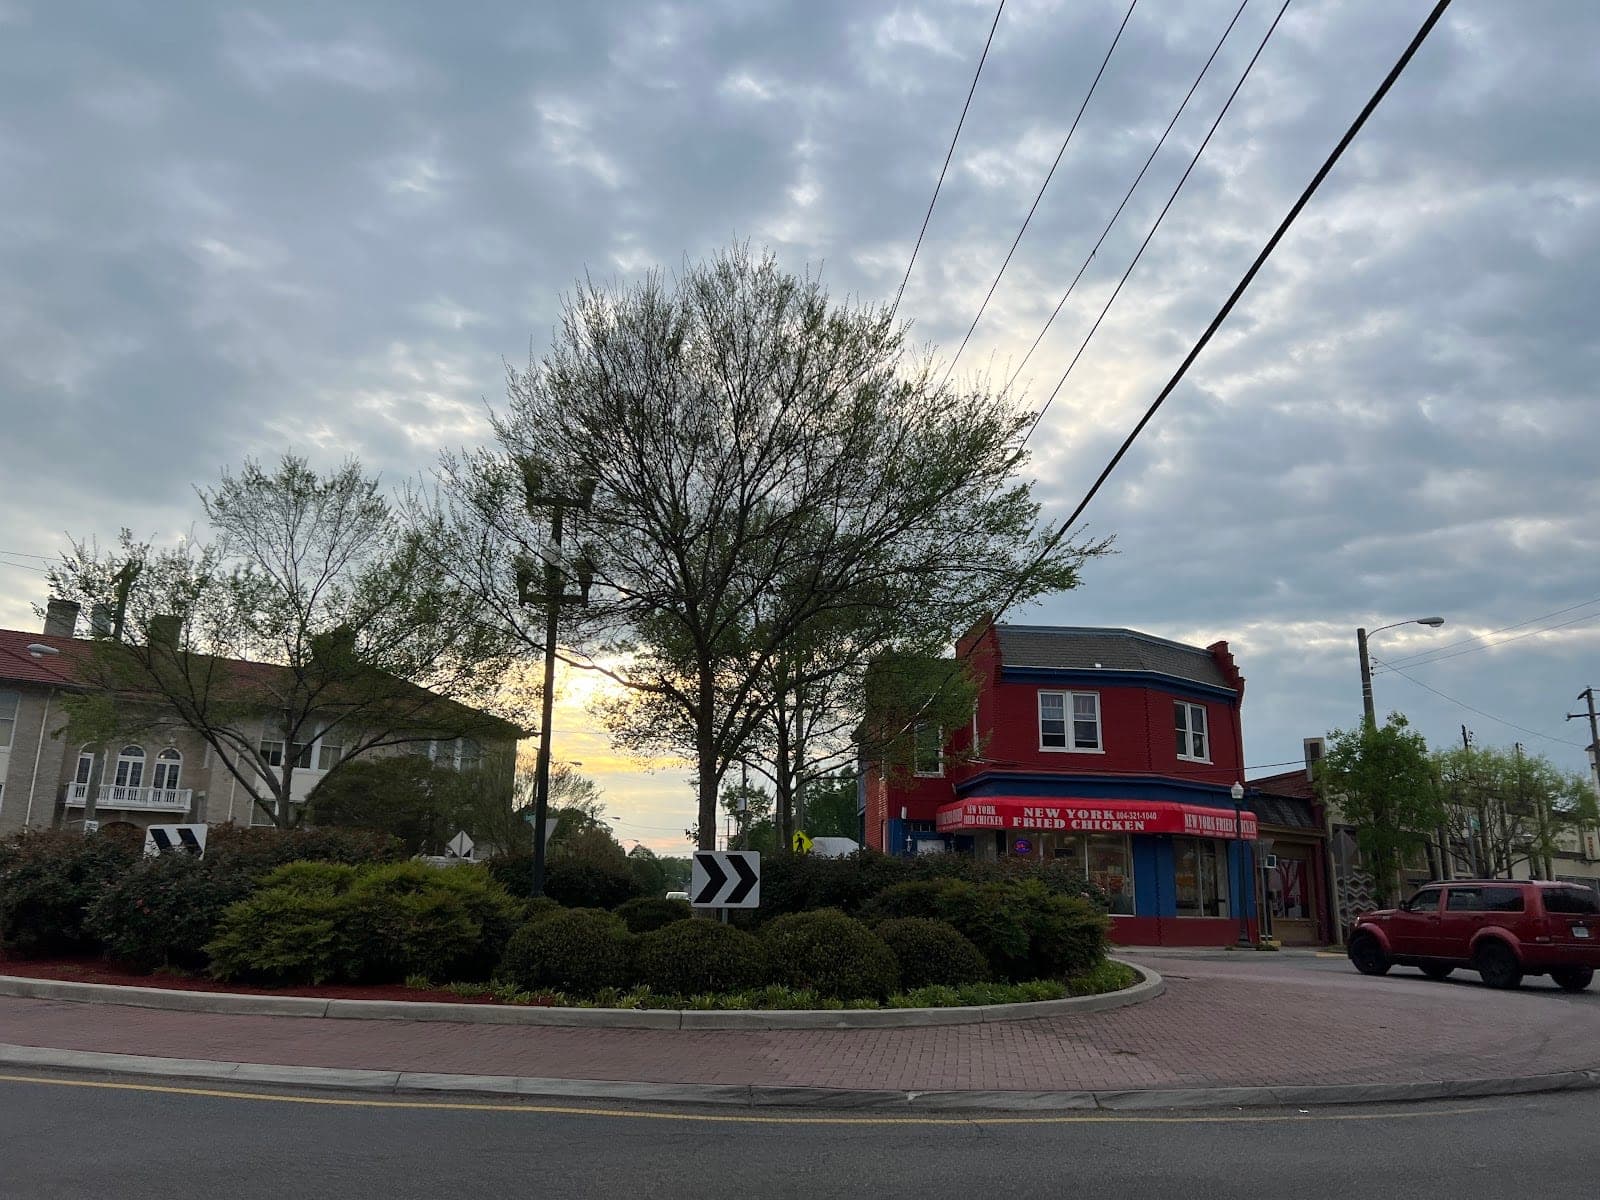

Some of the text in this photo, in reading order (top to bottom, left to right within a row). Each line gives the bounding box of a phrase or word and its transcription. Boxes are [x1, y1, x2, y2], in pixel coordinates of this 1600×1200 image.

[978, 805, 996, 815] YORK
[1023, 807, 1060, 818] NEW
[1065, 808, 1115, 820] YORK
[976, 815, 1003, 825] CHICKEN
[1012, 816, 1145, 831] FRIED CHICKEN
[1184, 814, 1256, 833] NEW YORK FRIED CICKEN
